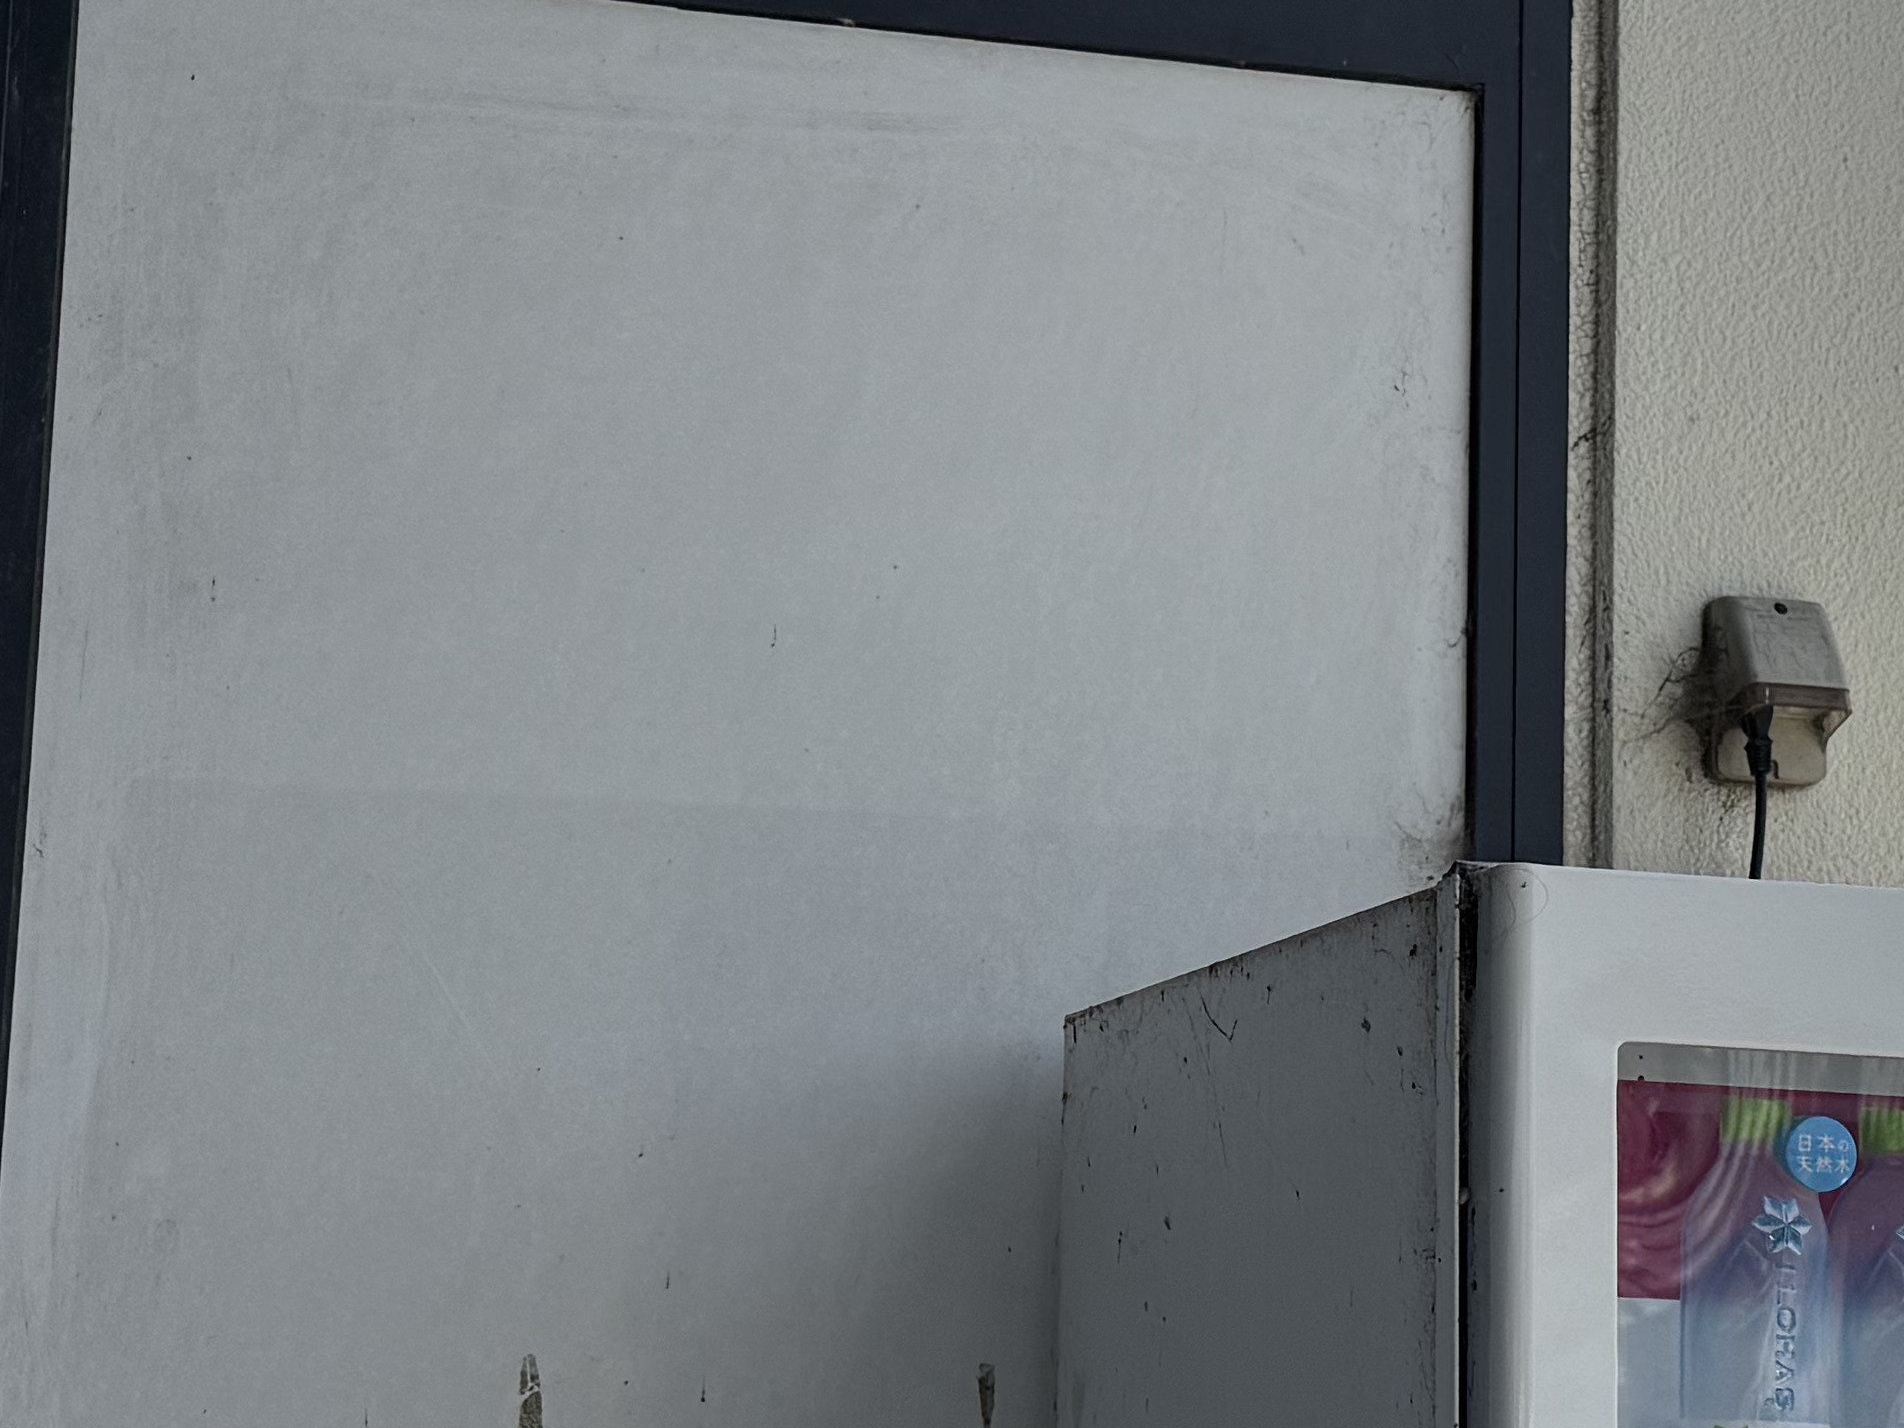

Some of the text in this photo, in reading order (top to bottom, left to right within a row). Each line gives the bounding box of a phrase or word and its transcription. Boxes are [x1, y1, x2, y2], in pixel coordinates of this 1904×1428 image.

[1798, 1134, 1849, 1152] 日本の
[1798, 1157, 1850, 1173] 天然水
